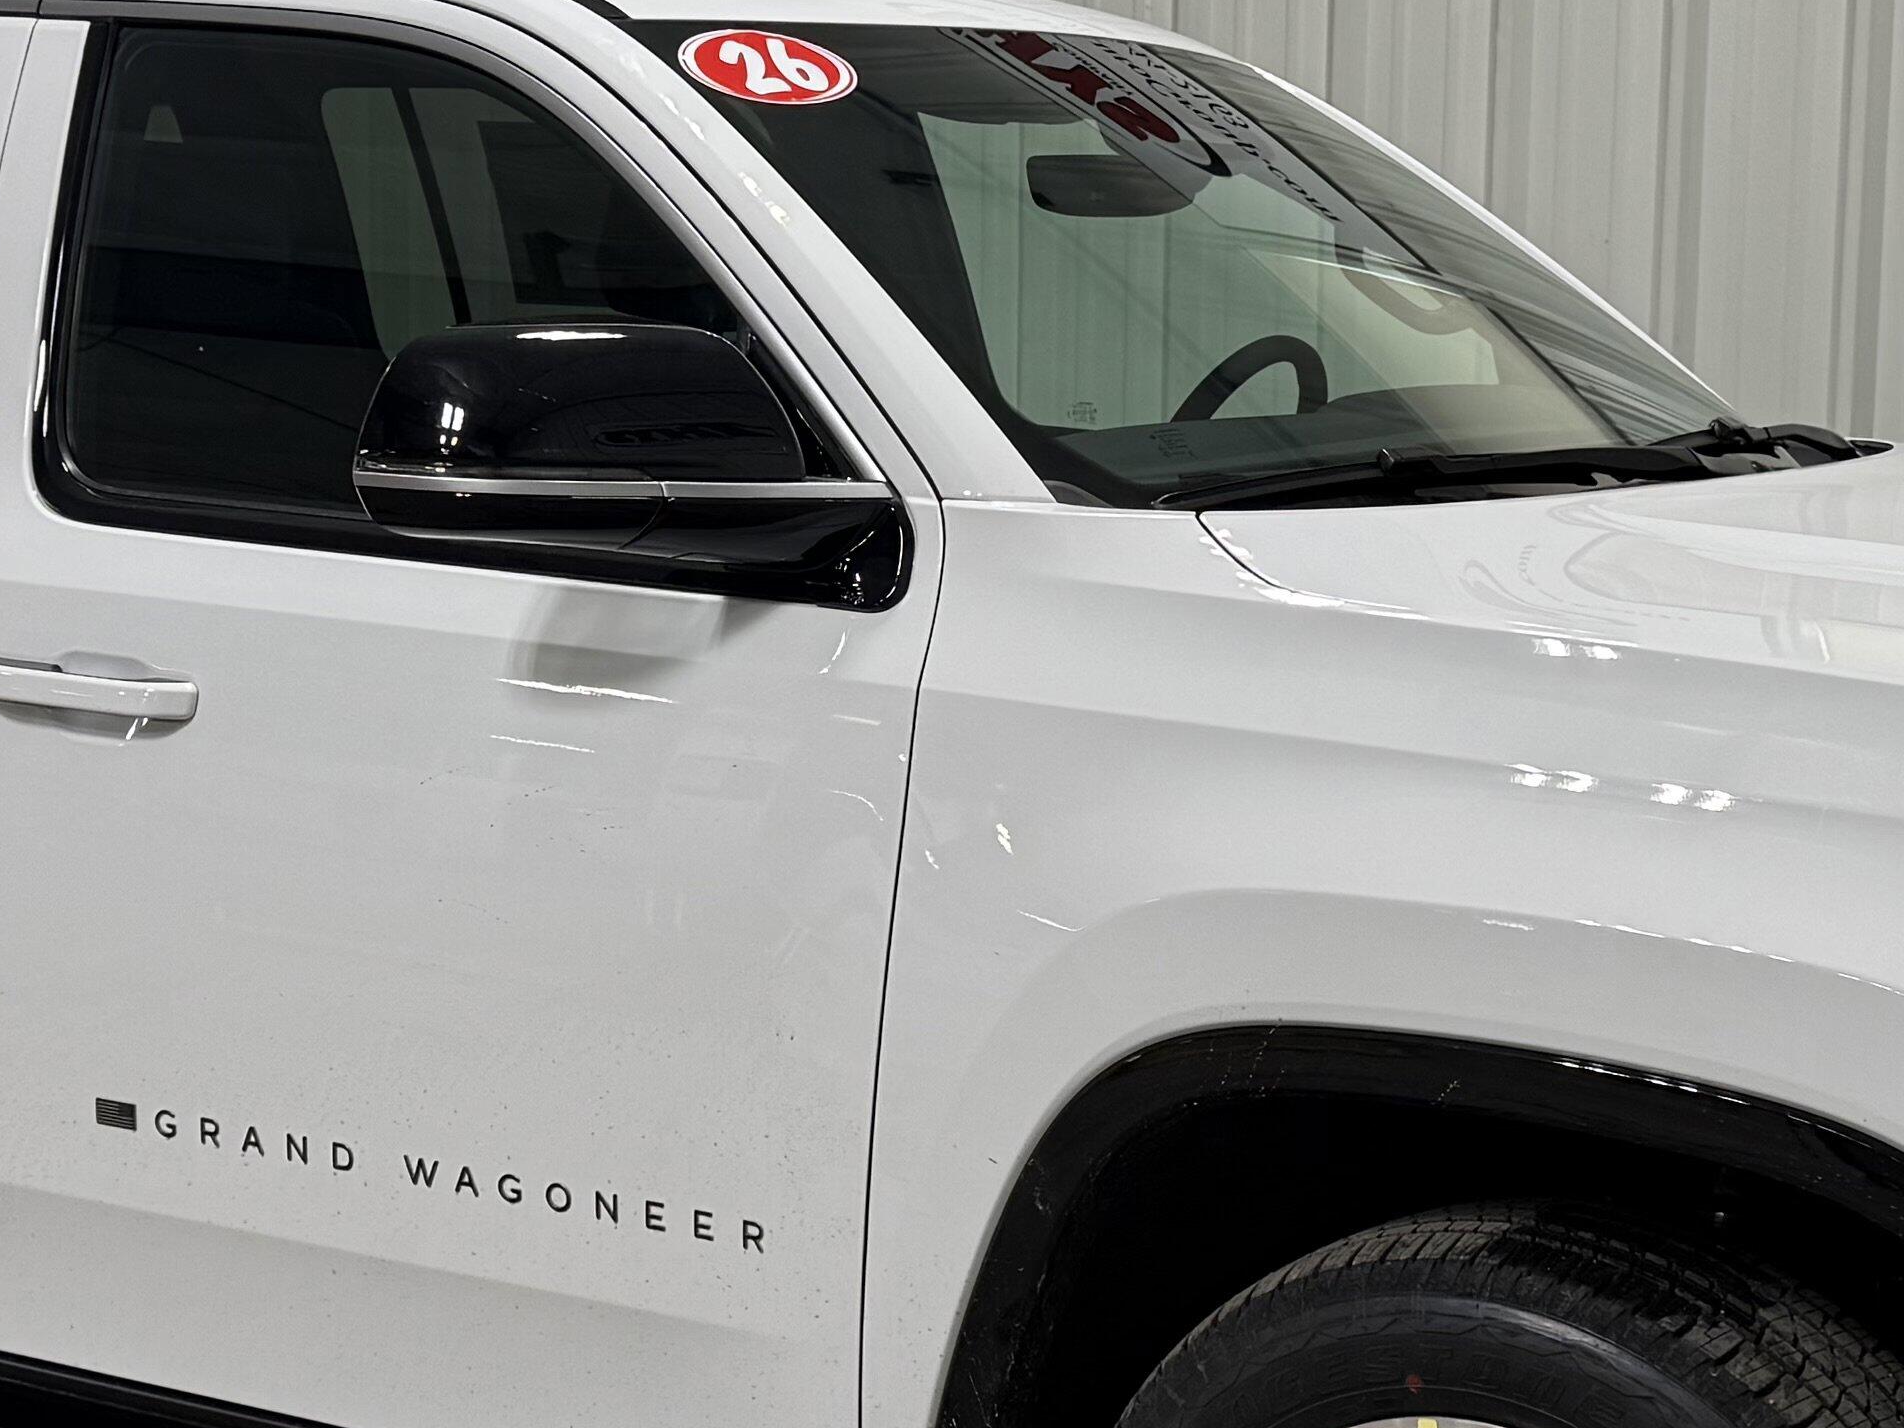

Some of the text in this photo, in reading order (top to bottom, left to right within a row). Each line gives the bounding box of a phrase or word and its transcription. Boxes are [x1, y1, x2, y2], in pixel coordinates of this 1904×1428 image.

[718, 38, 830, 94] 26
[154, 1108, 765, 1254] GRAND WAGONEER
